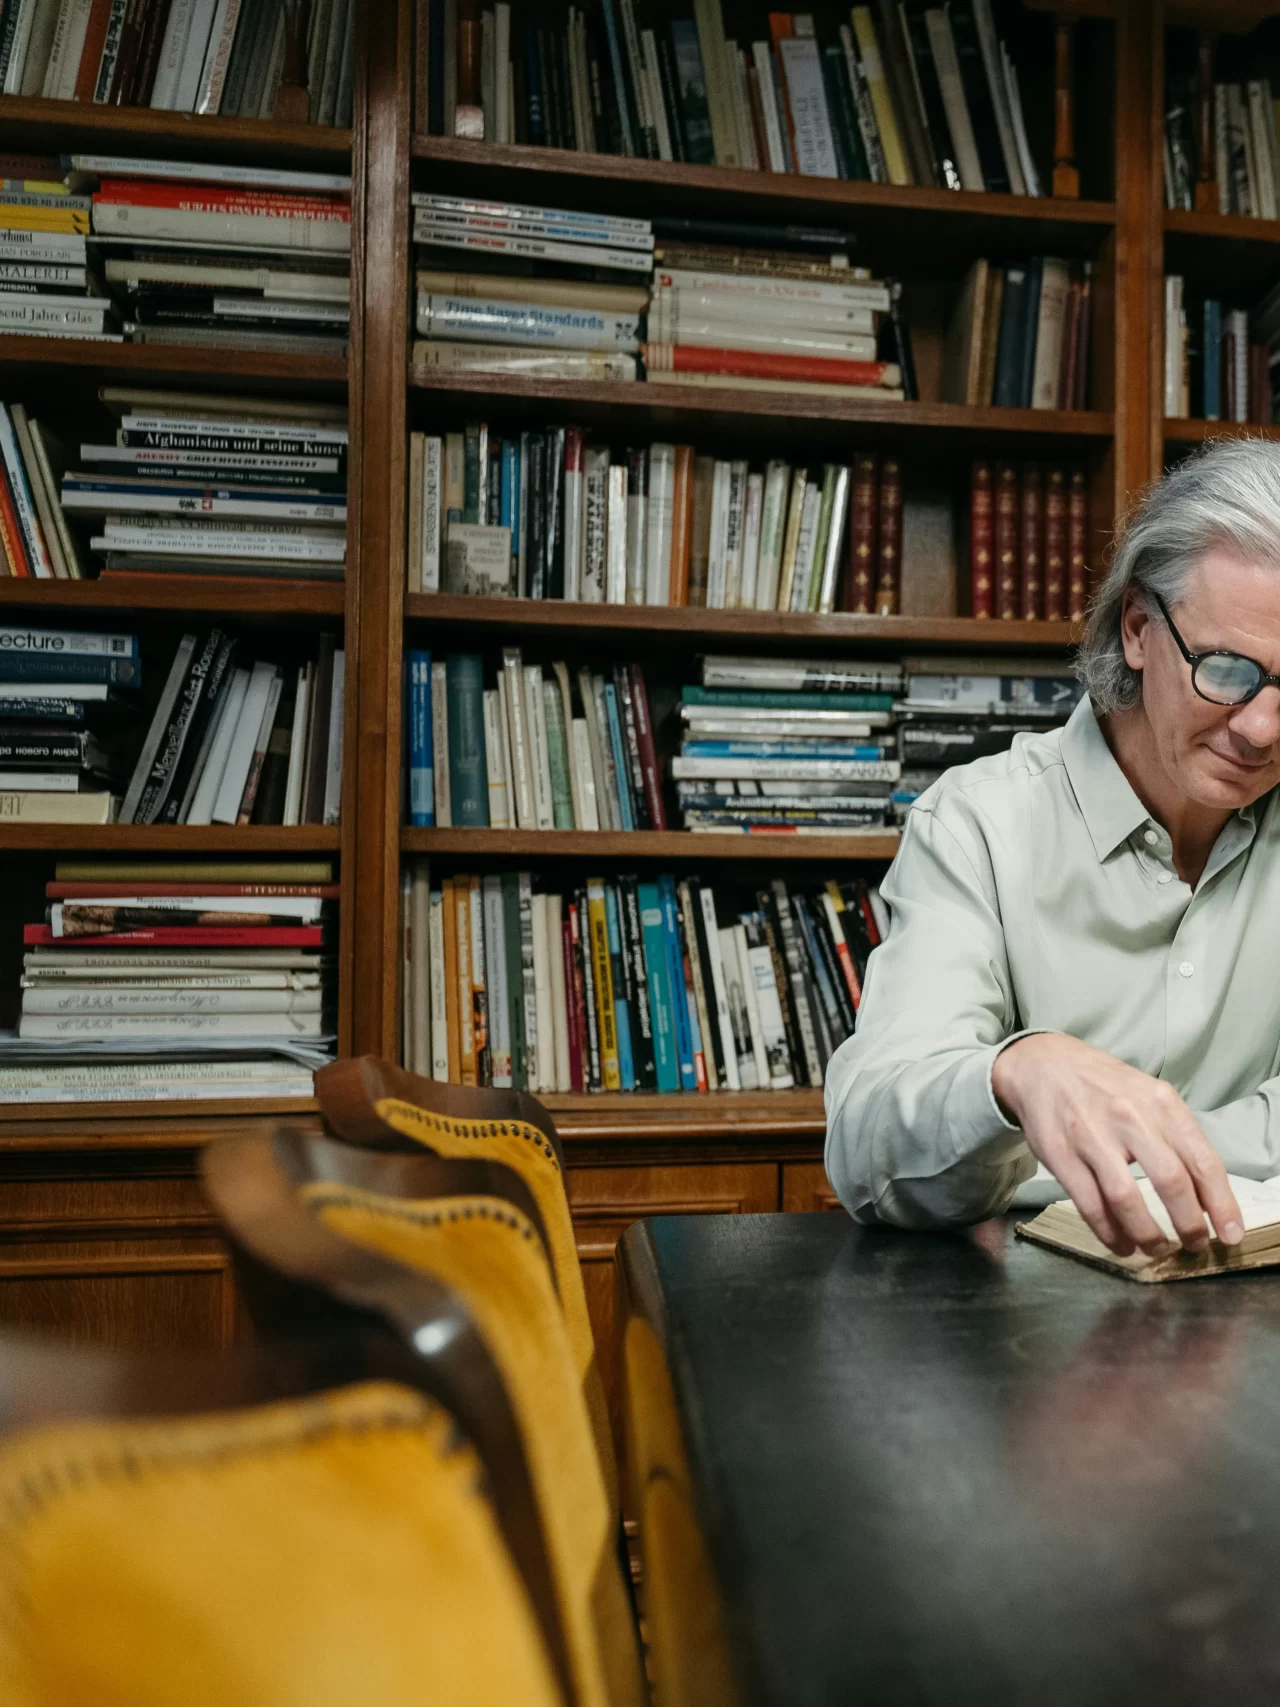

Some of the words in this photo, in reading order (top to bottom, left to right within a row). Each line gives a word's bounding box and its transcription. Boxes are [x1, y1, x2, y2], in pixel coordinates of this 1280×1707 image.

[29, 308, 61, 325] Jahre
[64, 310, 93, 324] Glas
[529, 310, 605, 331] Standards
[144, 432, 229, 450] Afghanistan
[233, 437, 260, 451] und
[263, 440, 300, 453] seine
[303, 442, 343, 456] Kunst
[0, 631, 65, 651] ecture
[15, 747, 50, 756] нового
[52, 748, 79, 758] мира
